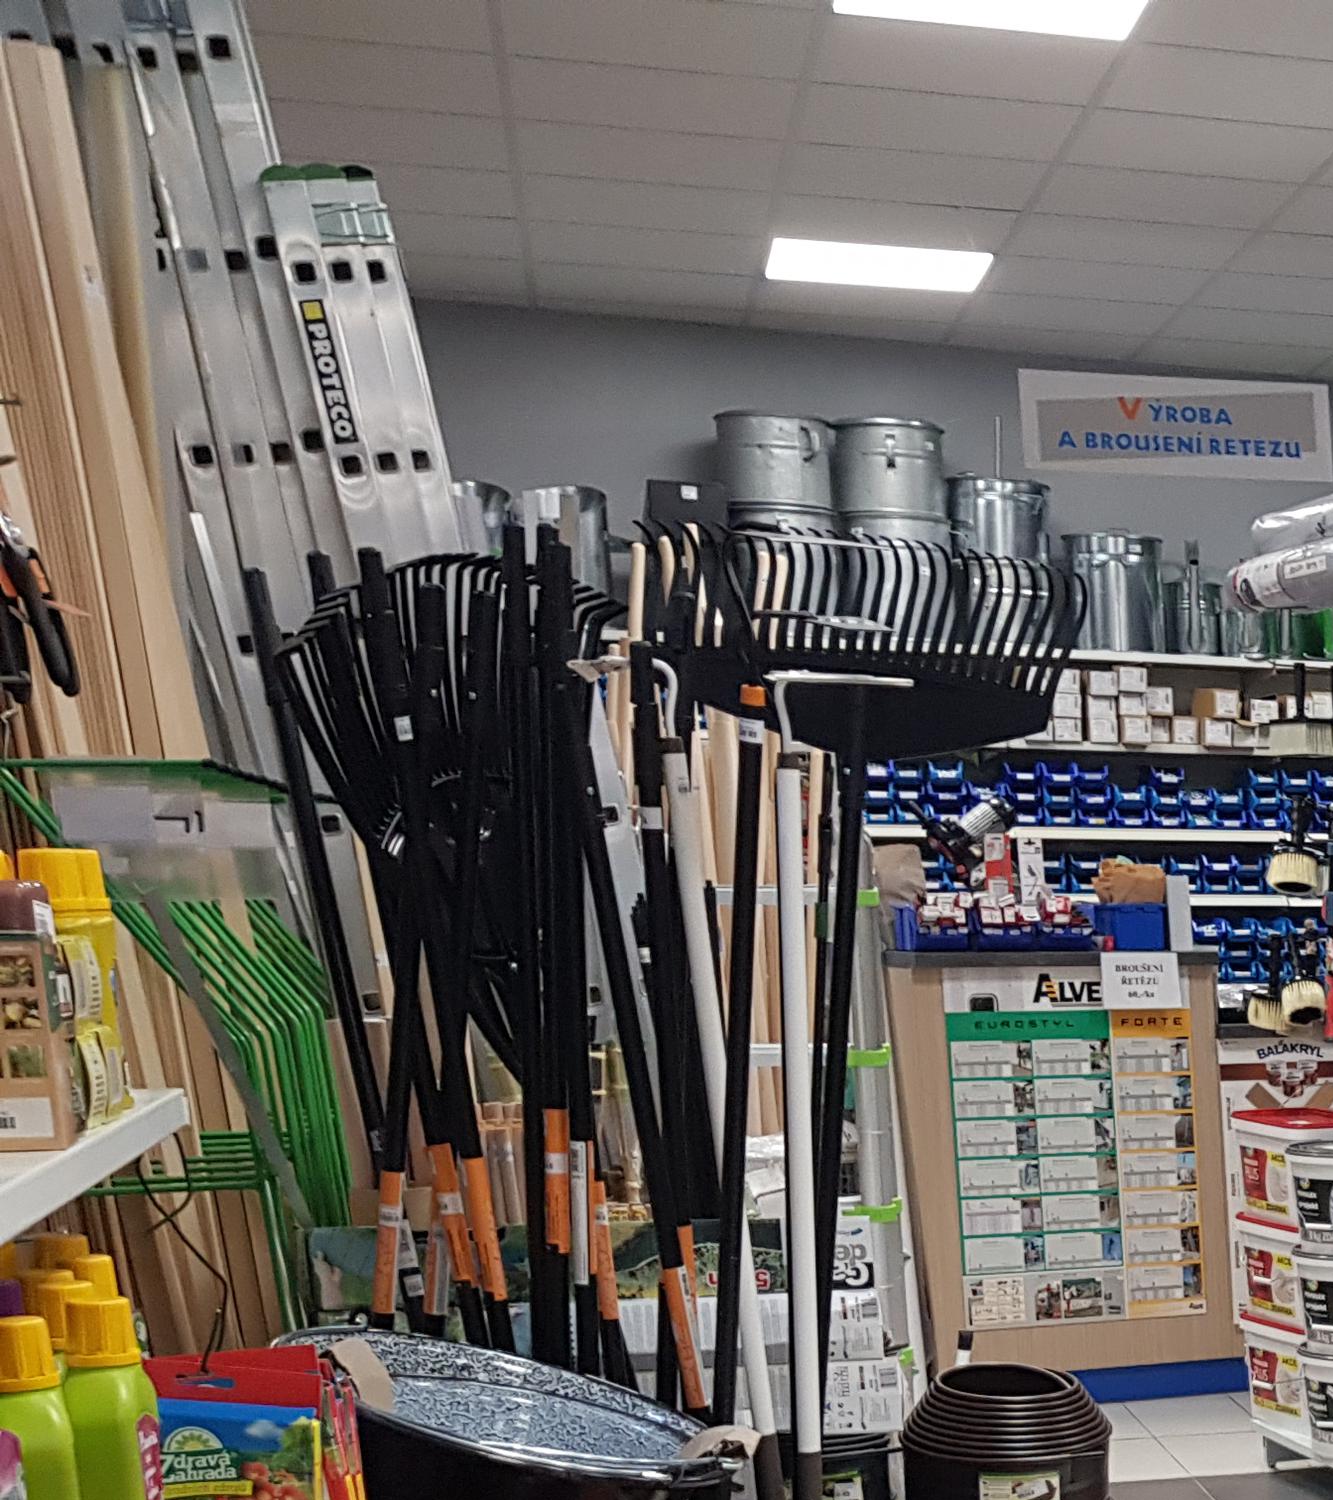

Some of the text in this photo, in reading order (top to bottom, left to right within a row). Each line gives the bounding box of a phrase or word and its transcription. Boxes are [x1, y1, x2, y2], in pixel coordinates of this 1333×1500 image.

[307, 321, 354, 438] PROTECO
[1057, 431, 1077, 449] A
[1032, 972, 1102, 1005] ALVE
[973, 1019, 1076, 1032] EUROSTYL
[1120, 1016, 1184, 1028] FORTE
[1256, 1042, 1325, 1060] BALAKRYL
